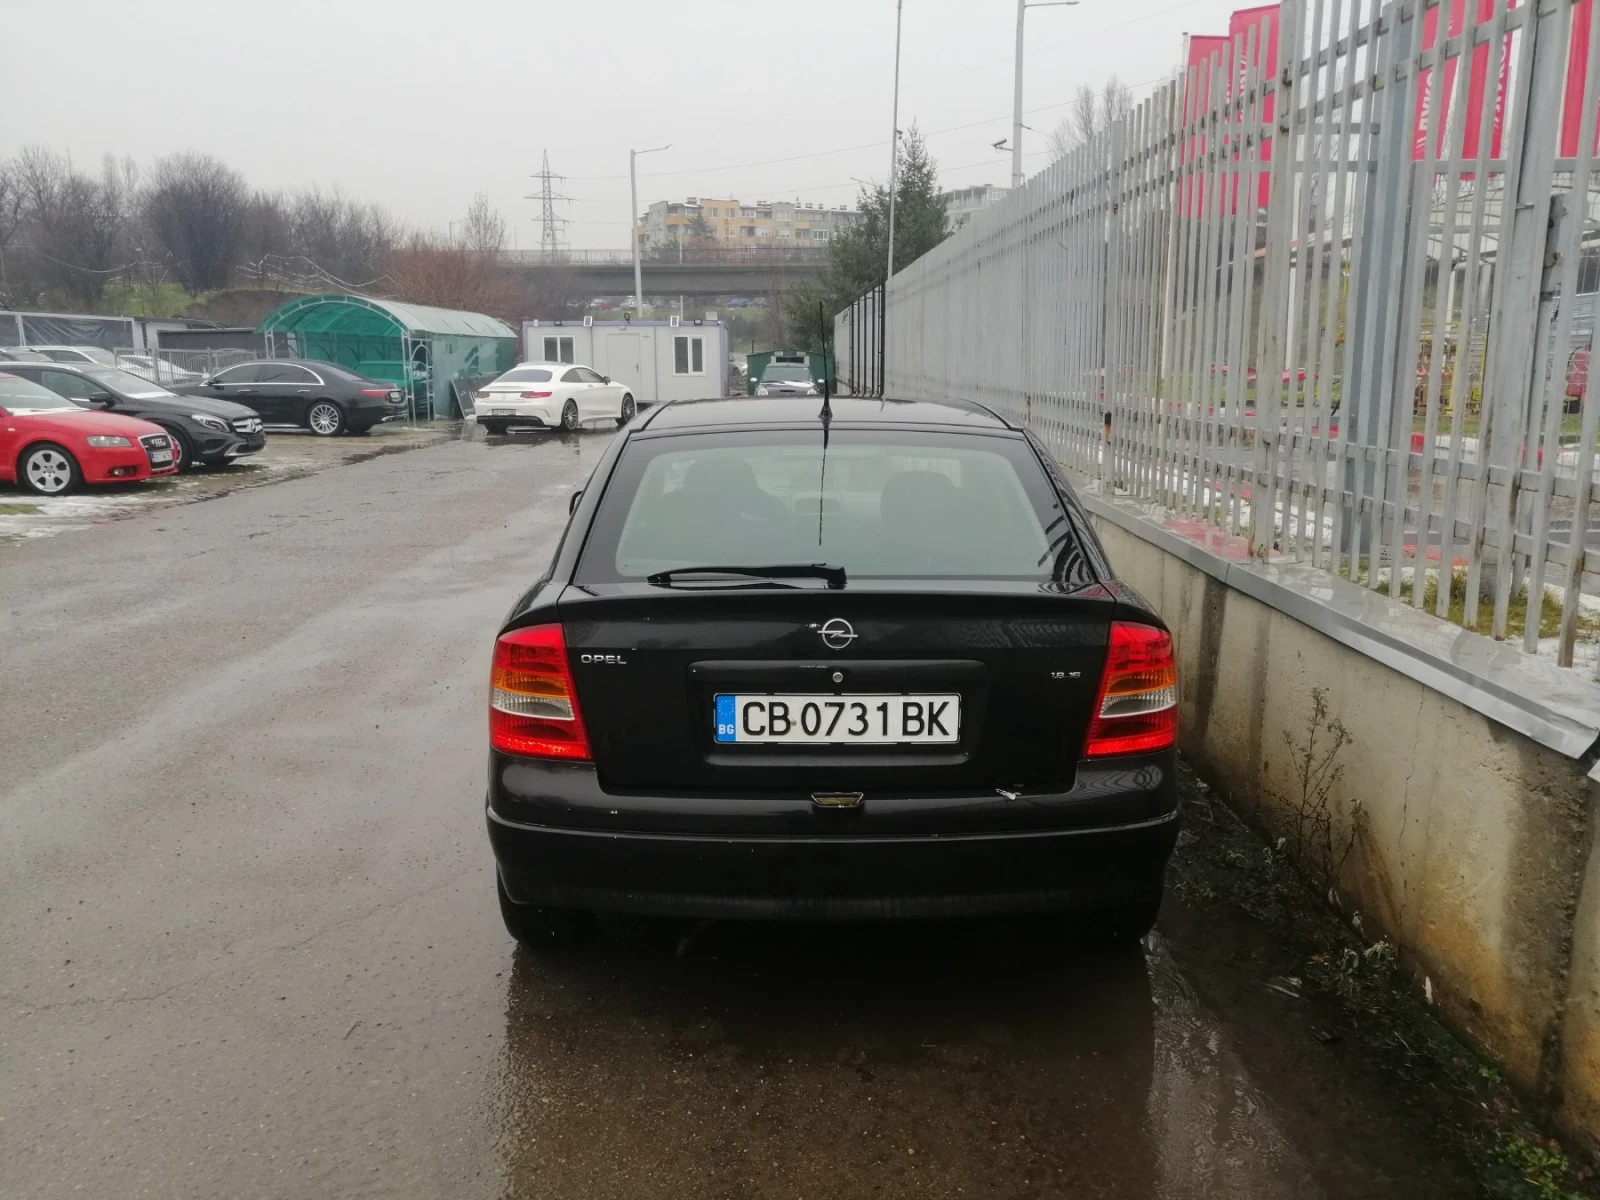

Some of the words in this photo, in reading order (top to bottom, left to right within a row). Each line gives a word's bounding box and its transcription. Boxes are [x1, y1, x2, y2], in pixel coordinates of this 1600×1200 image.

[580, 654, 627, 665] OPEL
[742, 701, 791, 737] CB
[800, 701, 888, 737] 0731
[901, 701, 950, 737] BK
[718, 723, 735, 735] BG
